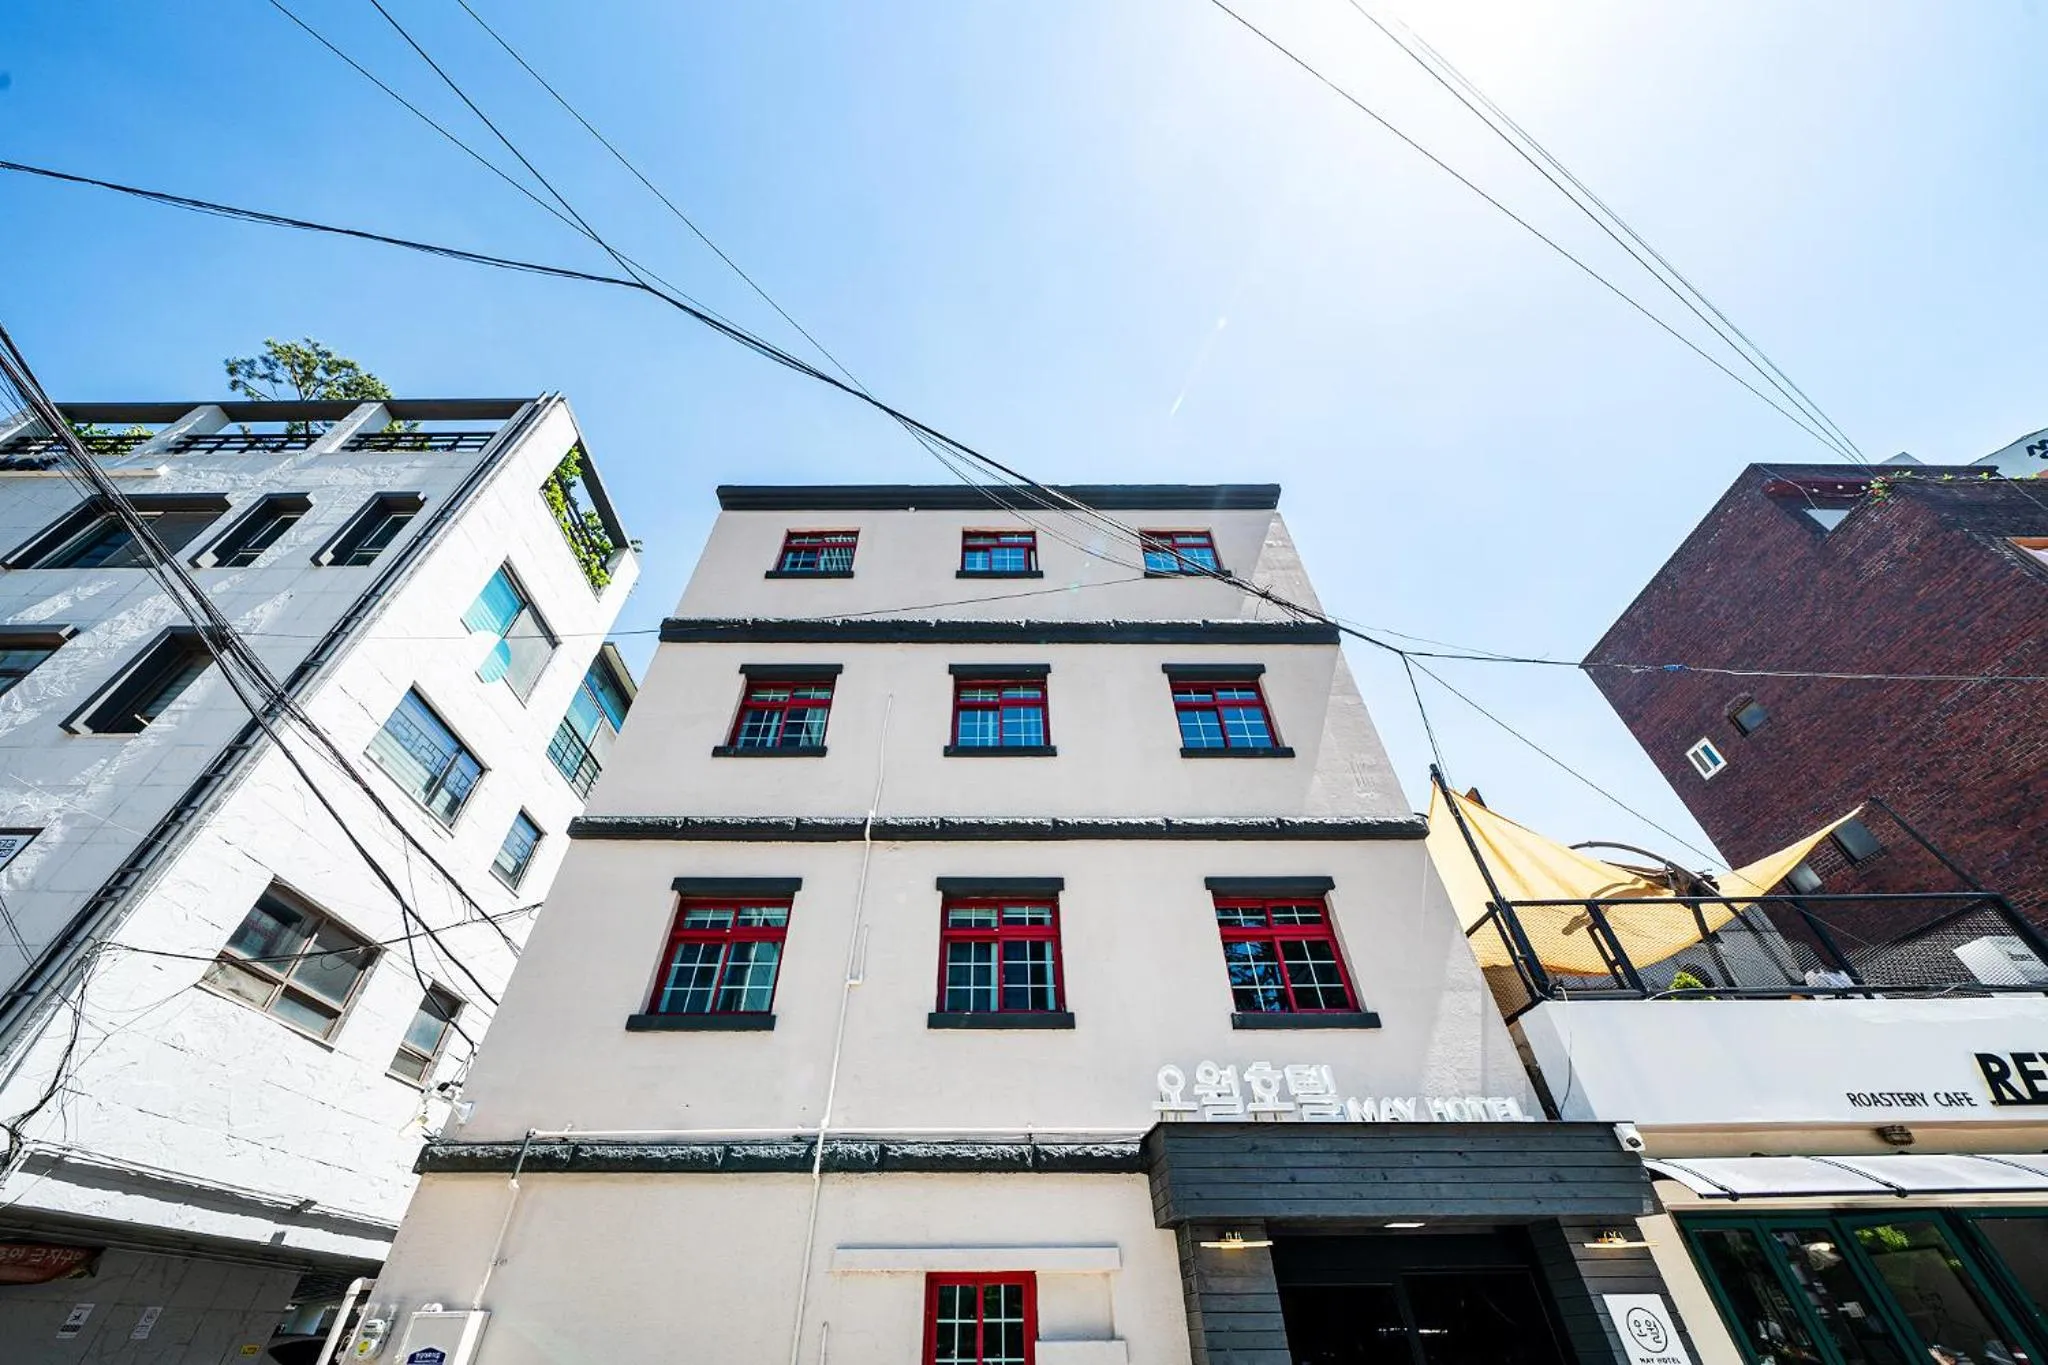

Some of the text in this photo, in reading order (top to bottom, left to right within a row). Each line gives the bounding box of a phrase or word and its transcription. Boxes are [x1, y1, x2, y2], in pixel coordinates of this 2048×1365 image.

[1152, 1060, 1346, 1121] 오월호텔
[1974, 1052, 2048, 1105] RE
[1346, 1096, 1535, 1122] MAY HOTEL
[1846, 1092, 1978, 1108] ROASTERY CAFE
[1639, 1357, 1682, 1365] MAY HOTEL
